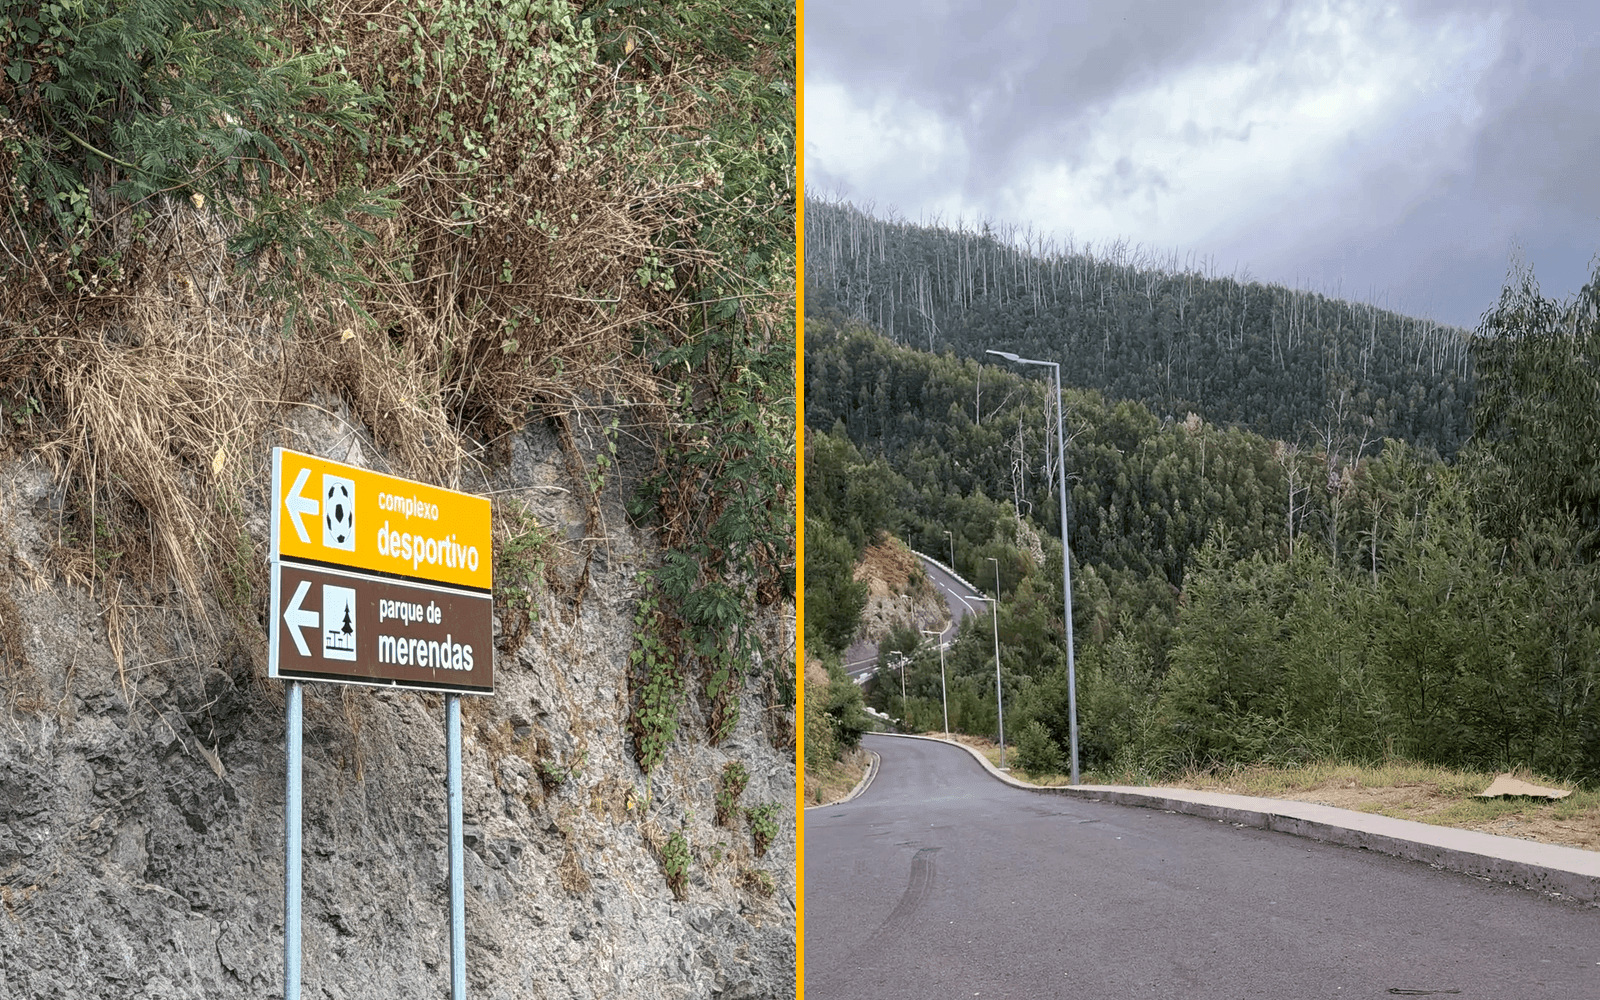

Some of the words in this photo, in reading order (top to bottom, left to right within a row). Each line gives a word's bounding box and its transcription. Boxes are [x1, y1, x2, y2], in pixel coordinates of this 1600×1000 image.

[378, 492, 439, 521] complexo
[377, 520, 479, 572] desportivo
[379, 598, 424, 626] parque
[426, 601, 442, 625] de
[378, 634, 474, 671] merendas
